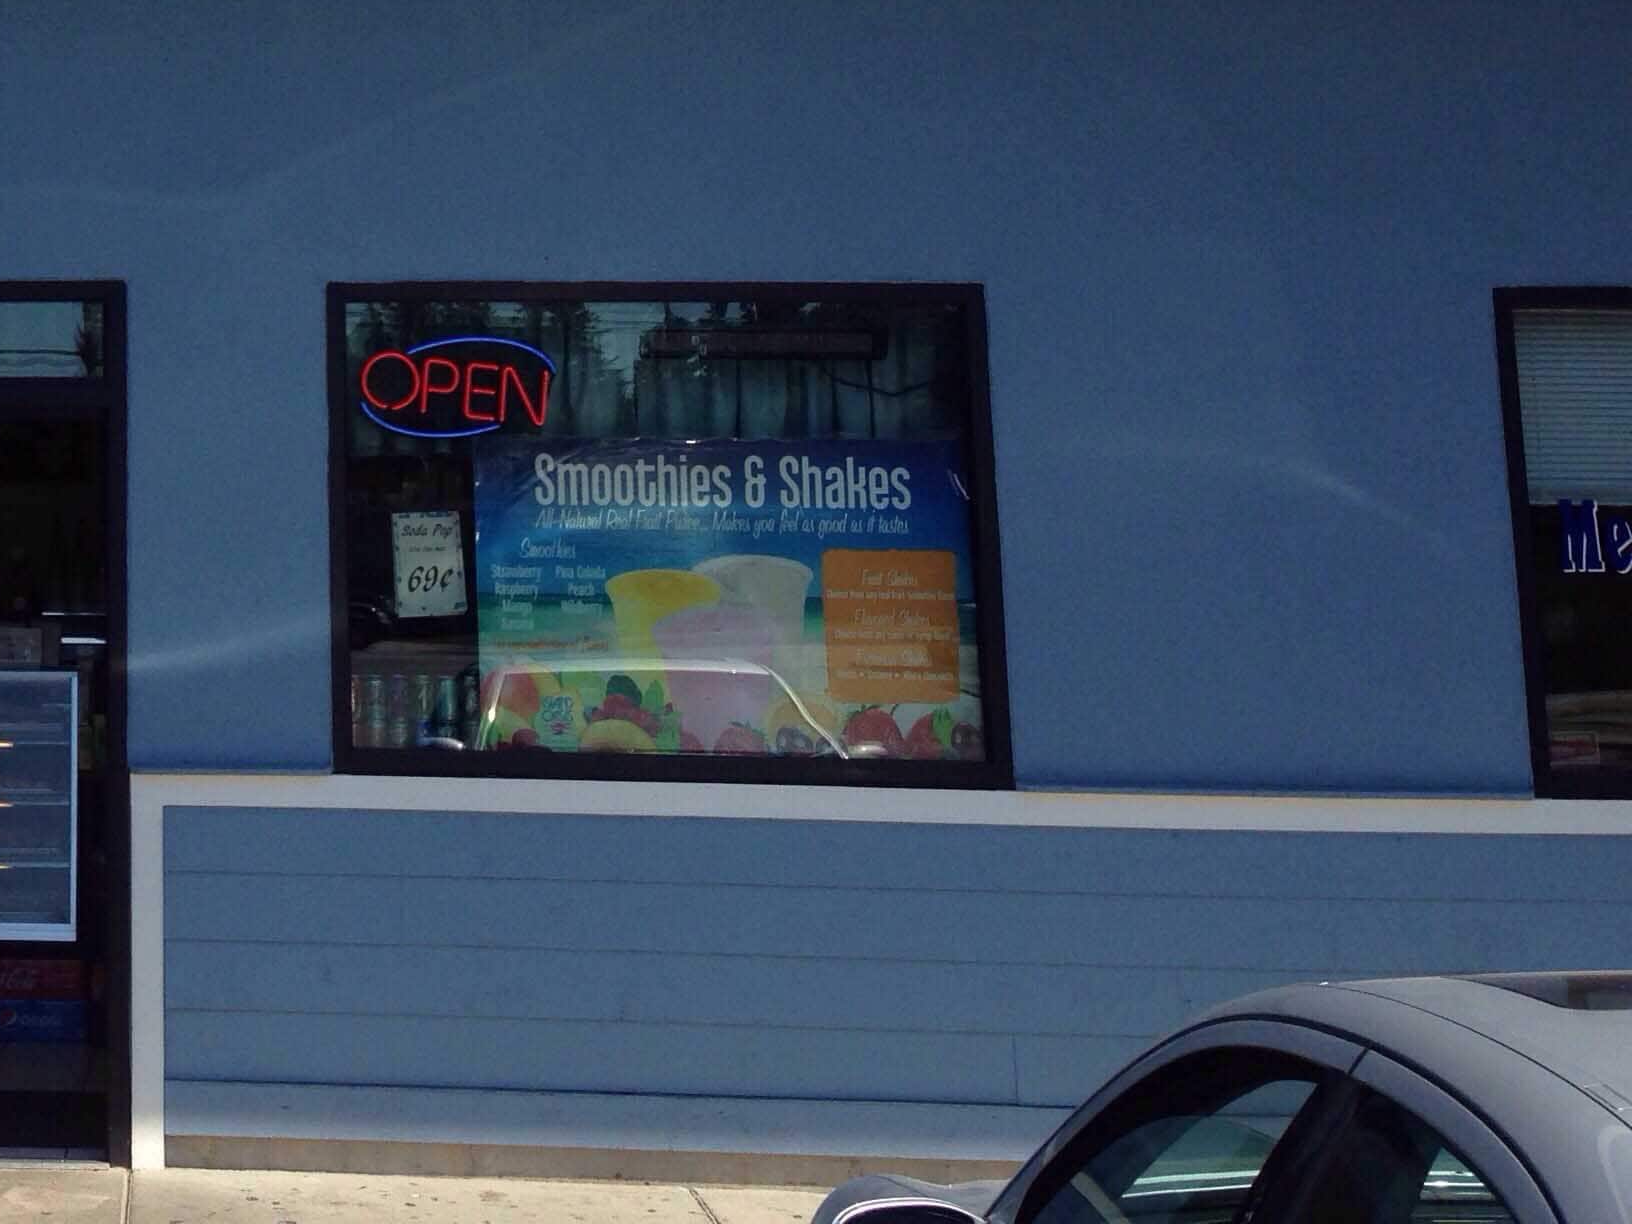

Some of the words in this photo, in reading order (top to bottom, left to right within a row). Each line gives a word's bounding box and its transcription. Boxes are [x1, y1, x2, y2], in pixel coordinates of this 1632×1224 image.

[361, 350, 552, 427] OPEN
[535, 453, 738, 509] Smoothies
[744, 455, 769, 509] &
[778, 456, 912, 512] Shakes
[401, 524, 428, 537] Soda
[432, 523, 454, 540] Pop
[753, 519, 776, 539] you
[818, 513, 848, 539] good
[408, 565, 453, 593] 69¢
